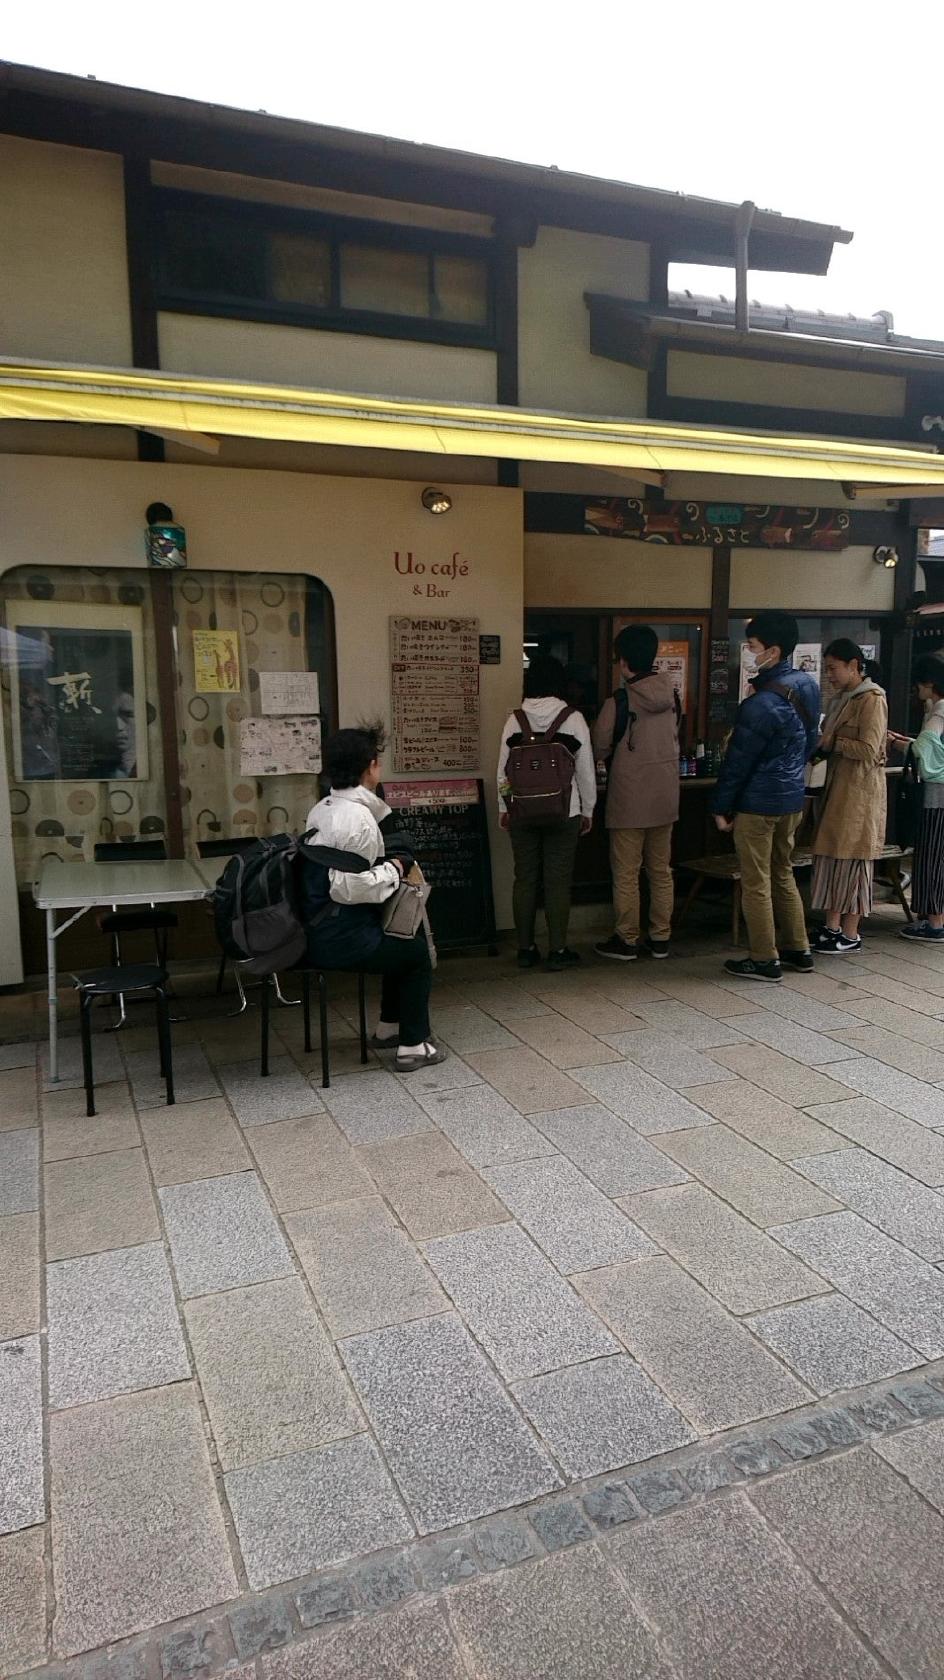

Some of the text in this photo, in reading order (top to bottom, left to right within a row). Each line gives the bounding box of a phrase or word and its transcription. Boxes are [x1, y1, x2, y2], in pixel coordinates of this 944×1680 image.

[393, 551, 469, 580] Uo café
[412, 583, 451, 598] & Bar
[411, 619, 446, 631] MENU
[448, 803, 469, 815] TOP
